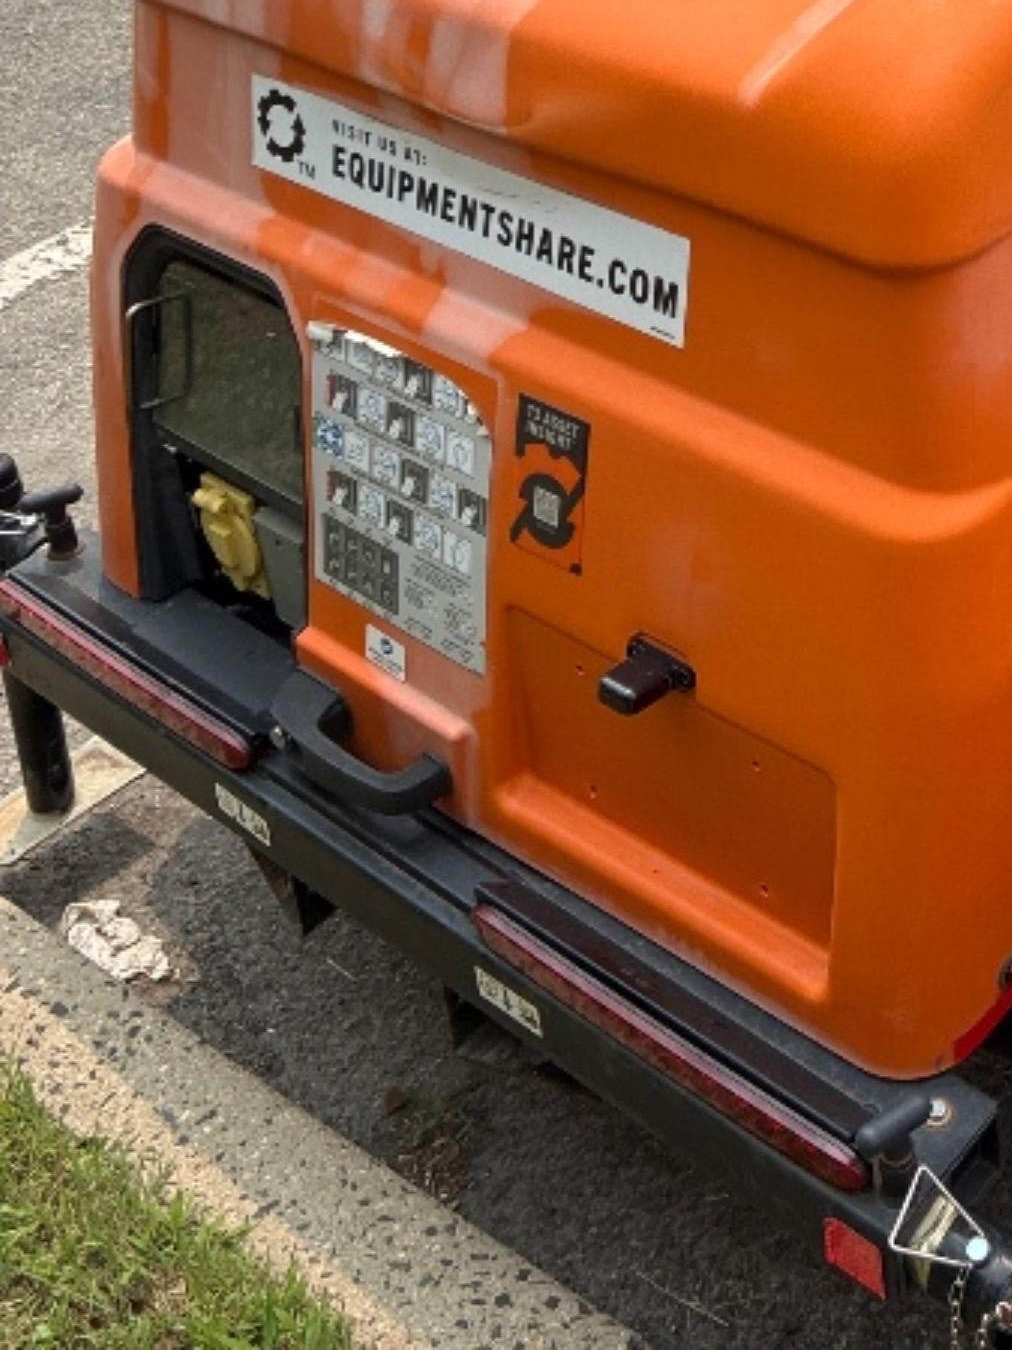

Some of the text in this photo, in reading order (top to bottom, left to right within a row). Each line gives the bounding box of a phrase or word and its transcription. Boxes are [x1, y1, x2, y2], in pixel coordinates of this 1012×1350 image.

[331, 118, 372, 146] VISIT
[377, 135, 397, 157] US
[298, 159, 316, 180] TM
[332, 144, 679, 319] EQUIPMENTSHARE.COM
